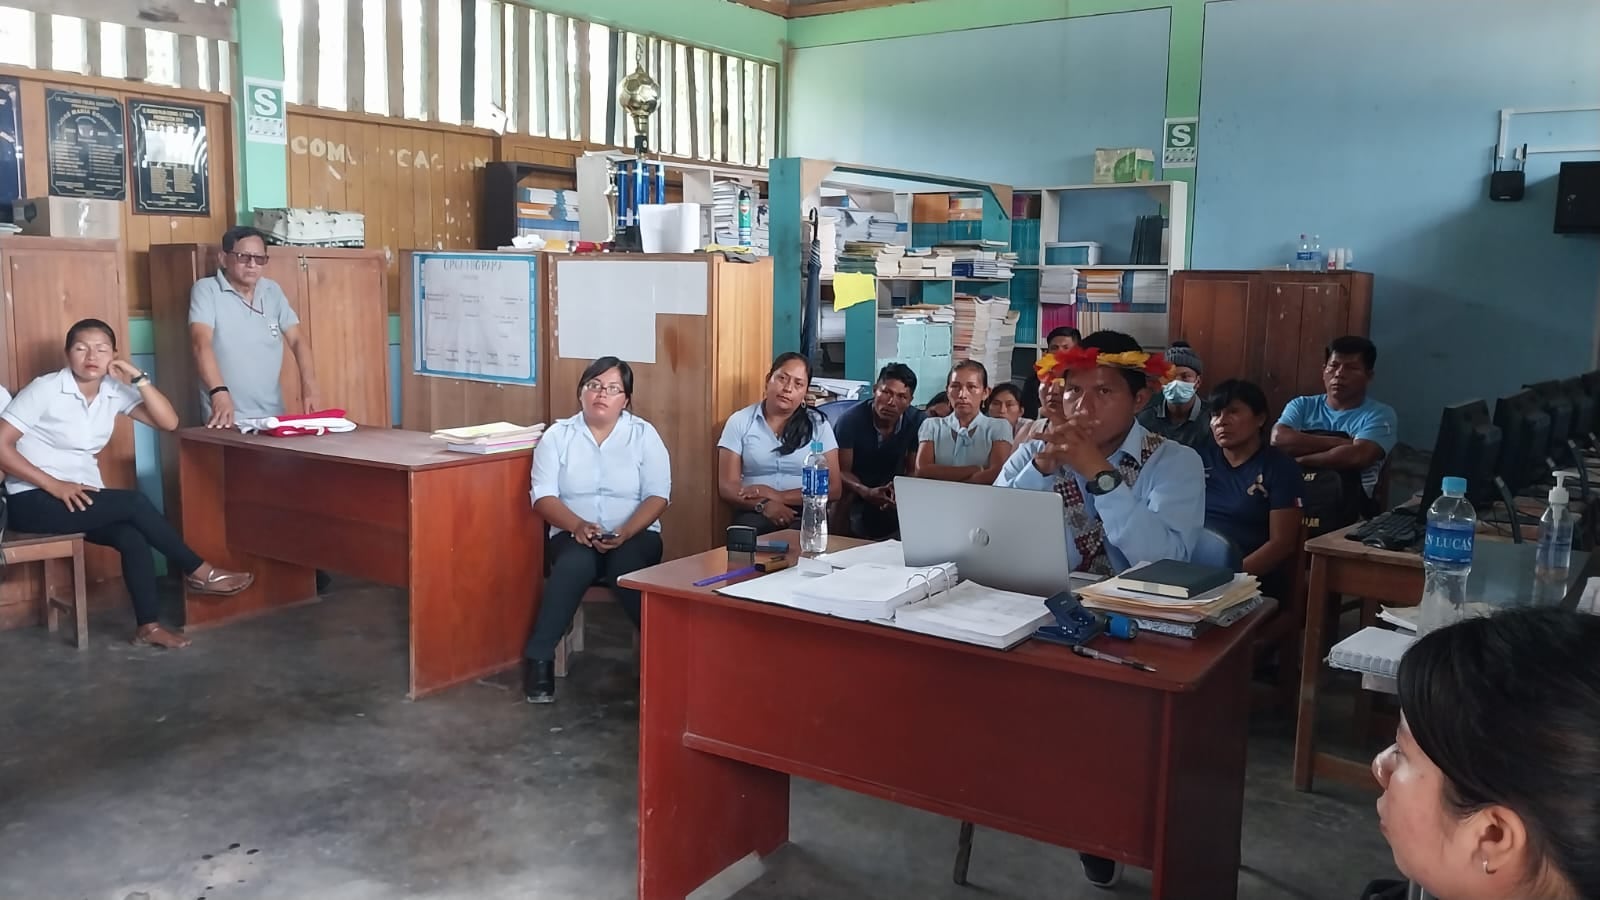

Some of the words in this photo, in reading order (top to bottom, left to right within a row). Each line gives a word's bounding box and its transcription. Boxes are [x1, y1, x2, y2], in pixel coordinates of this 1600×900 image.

[255, 89, 277, 115] S
[1172, 125, 1191, 146] S
[1436, 536, 1472, 551] LUCAS
